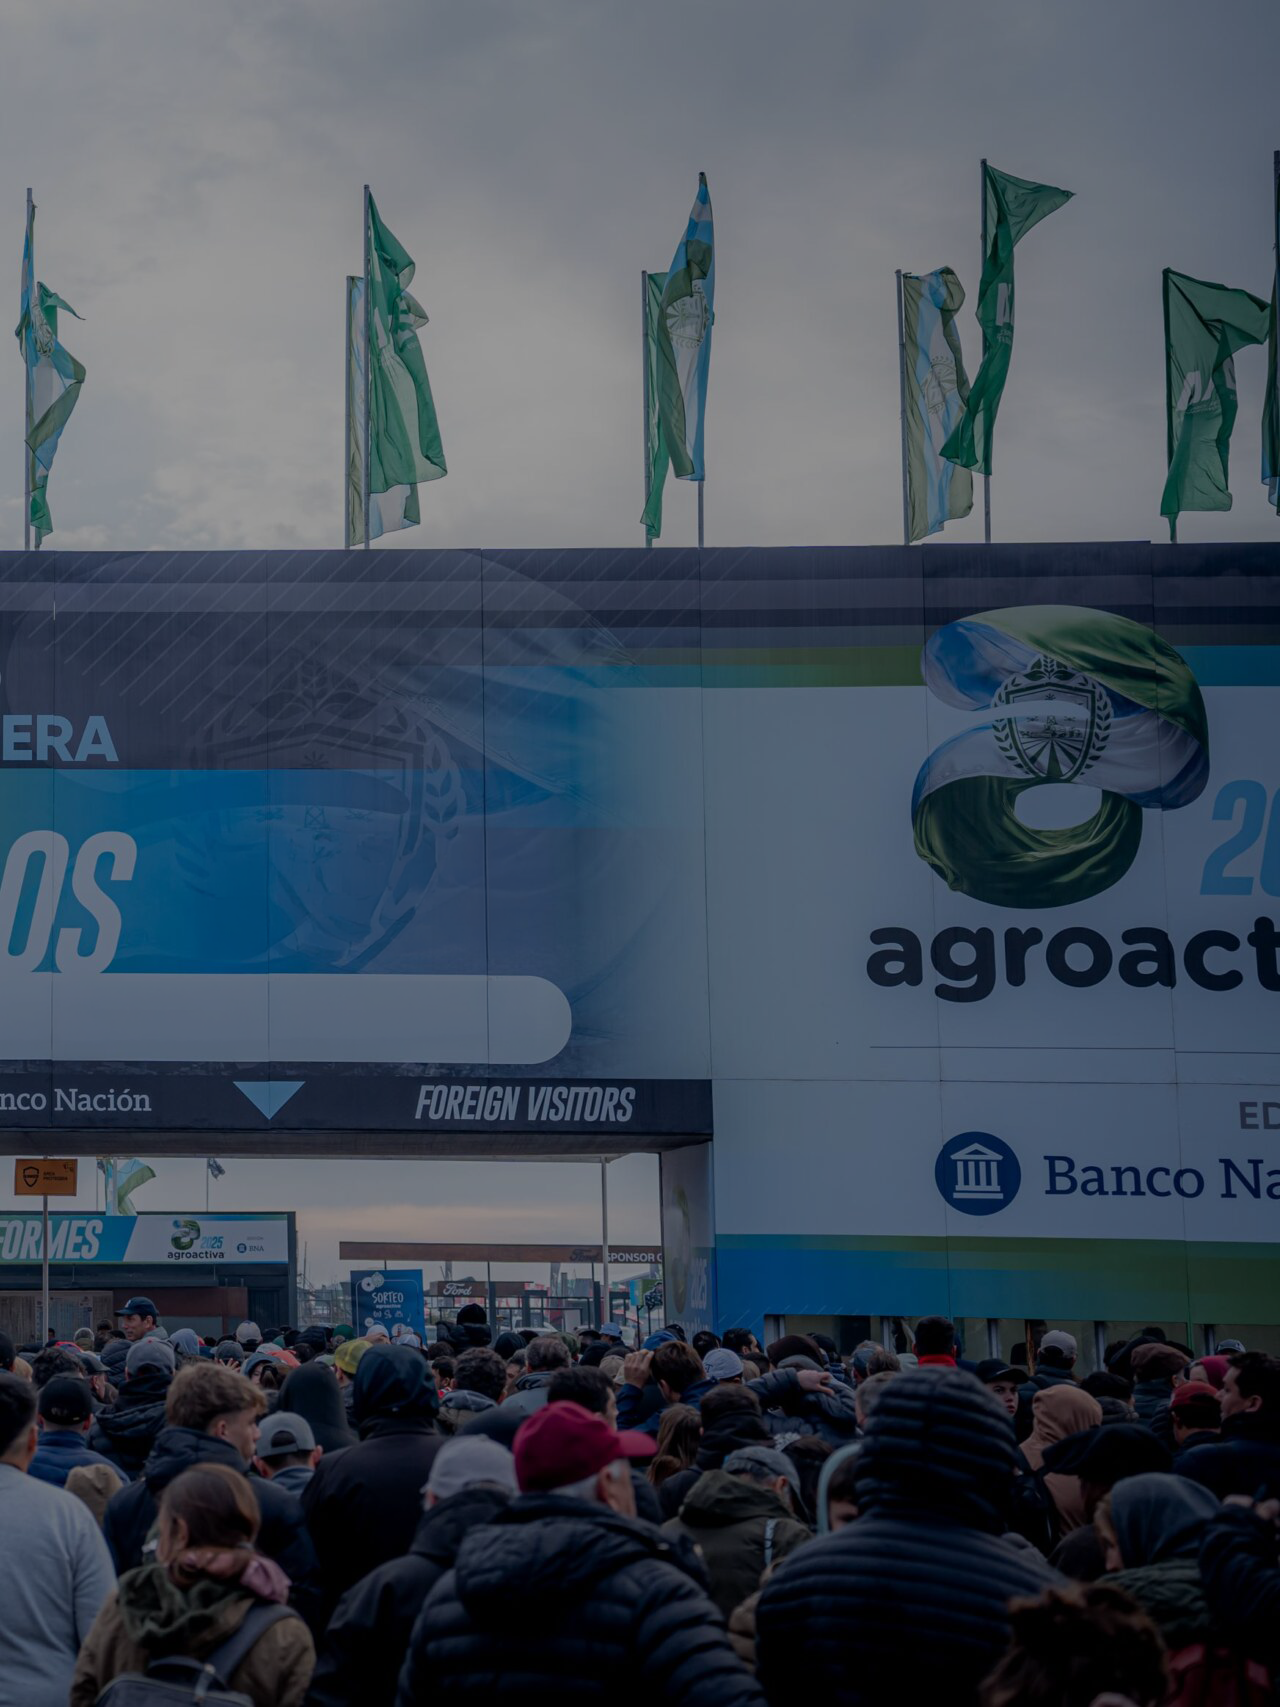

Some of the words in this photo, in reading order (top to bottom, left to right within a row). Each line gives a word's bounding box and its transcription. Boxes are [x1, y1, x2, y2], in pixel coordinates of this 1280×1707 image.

[866, 917, 1280, 1003] agroact
[54, 1087, 152, 1112] Nación
[415, 1085, 521, 1121] FOREIGN
[527, 1086, 636, 1122] VISITORS
[1043, 1155, 1204, 1199] Banco
[201, 1236, 224, 1249] 2025
[167, 1250, 225, 1260] agroactiva
[607, 1253, 655, 1262] SPONSOR
[443, 1283, 472, 1296] Ford
[372, 1291, 404, 1304] SORTEO
